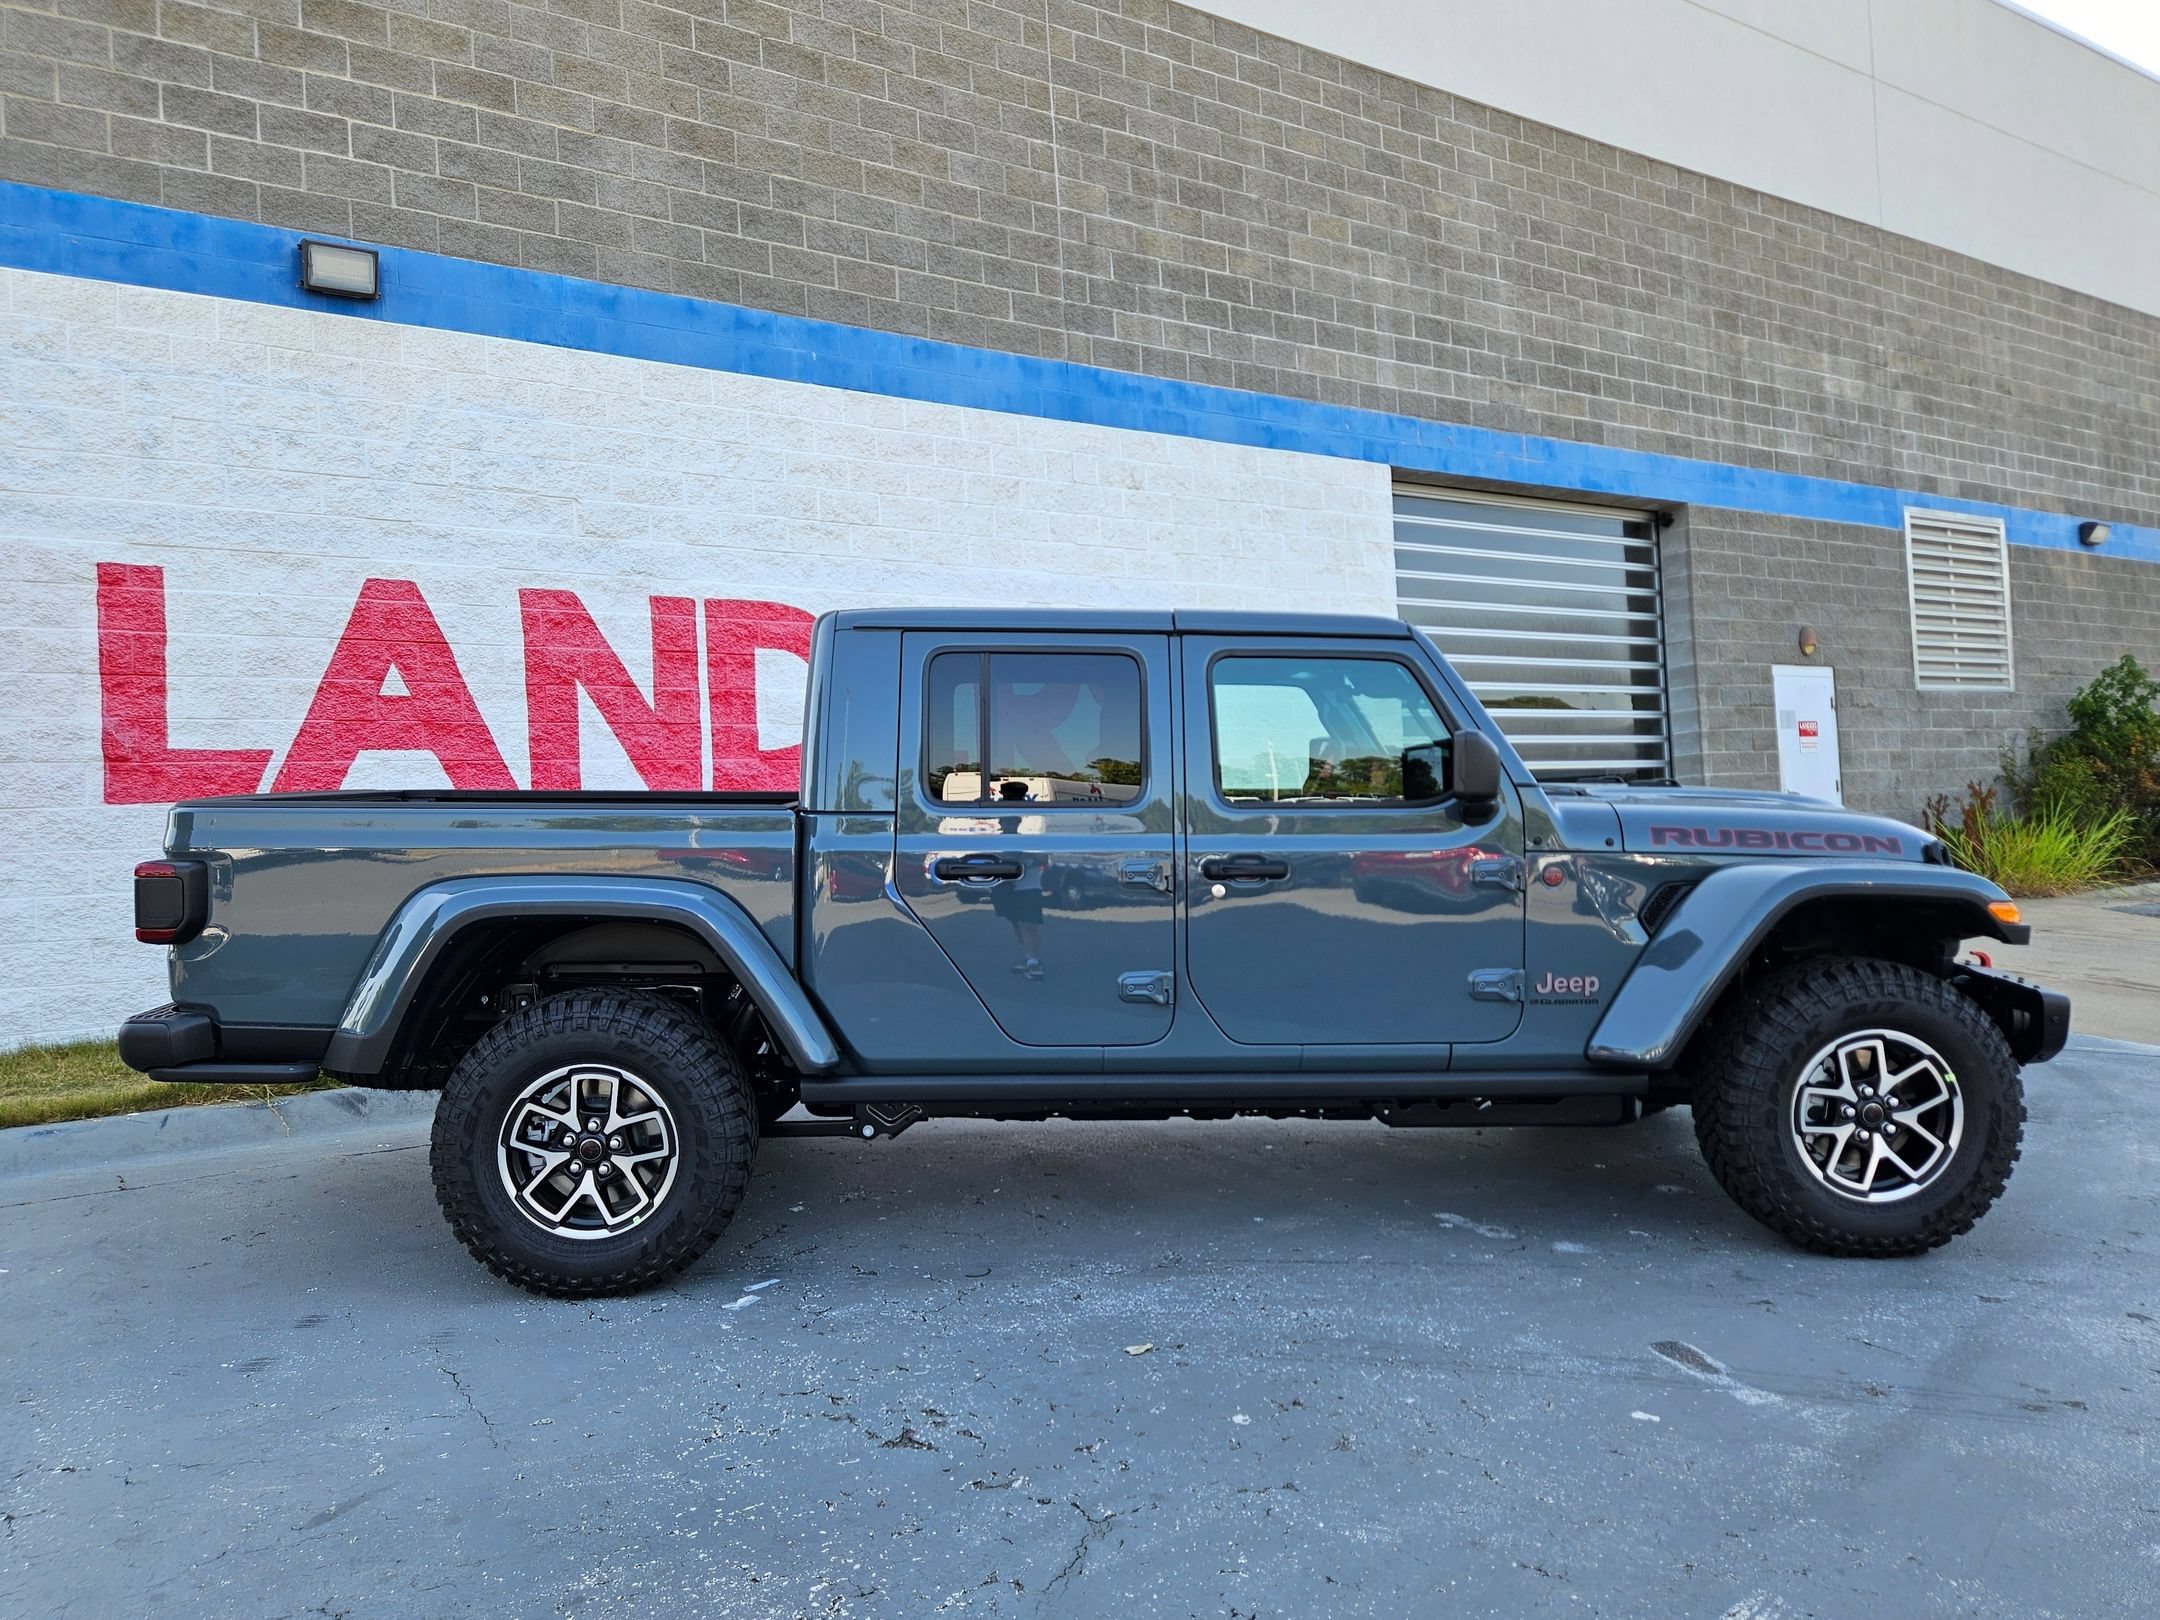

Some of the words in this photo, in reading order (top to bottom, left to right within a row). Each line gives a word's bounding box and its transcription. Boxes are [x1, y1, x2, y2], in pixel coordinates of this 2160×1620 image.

[1650, 826, 1902, 854] RUBICON
[1536, 971, 1600, 997] Jeep
[1540, 998, 1599, 1006] GLADIATOR
